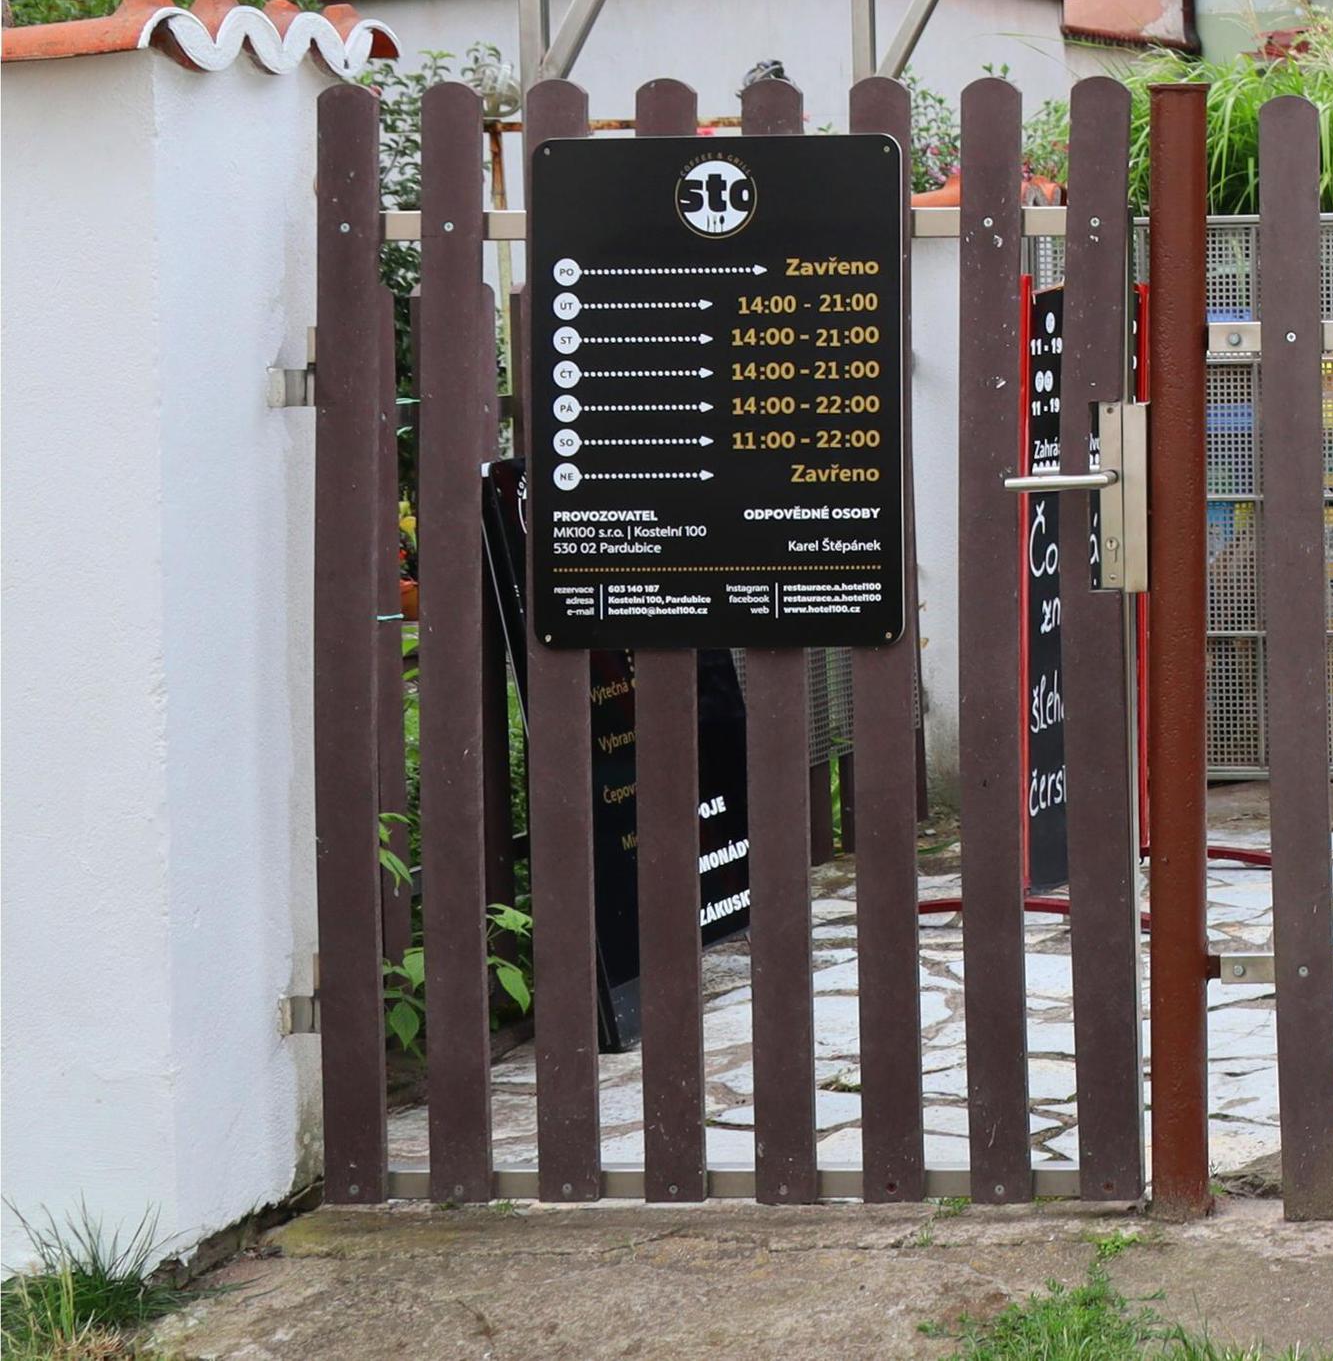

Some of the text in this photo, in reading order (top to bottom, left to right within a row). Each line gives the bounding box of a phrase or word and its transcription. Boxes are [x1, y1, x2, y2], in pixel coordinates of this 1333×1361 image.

[559, 256, 879, 277] PO Zavřeno
[738, 295, 797, 314] 14:00
[819, 293, 878, 312] 21:00
[560, 336, 573, 345] ST
[731, 328, 795, 346] 14:00
[816, 326, 880, 347] 21:00
[1031, 338, 1042, 356] 11
[1051, 337, 1063, 354] 19
[559, 369, 573, 379] ČT
[731, 362, 795, 381] 14:00
[814, 360, 880, 380] 21:00
[560, 402, 574, 413] PÁ
[731, 396, 796, 415] 14:00
[815, 395, 880, 414] 22:00
[1032, 401, 1041, 416] 11
[1050, 398, 1060, 413] 19
[560, 438, 574, 448] SO
[732, 431, 796, 450] 11:00
[816, 430, 880, 448] 22:00
[1034, 436, 1060, 459] Zahrá
[560, 464, 880, 483] NE Zavřeno
[553, 510, 658, 522] PROVOZOVATEL
[743, 506, 881, 520] ODPOVĚDNÉ OSOBY
[553, 525, 707, 538] MK100 s.r.o. Kostelní 100
[553, 542, 662, 554] 530 02 Pardubice
[788, 537, 881, 553] Karel Štěpánek
[553, 586, 595, 594] rezervace
[728, 594, 770, 604] facebook
[565, 596, 595, 605] adresa
[608, 595, 645, 604] Kostelní
[665, 595, 712, 604] Pardubice
[566, 607, 595, 616] e-mail
[750, 605, 861, 614] web www.hotel100.cz
[603, 783, 637, 805] Čepov
[700, 889, 751, 927] ZÁKUSK
